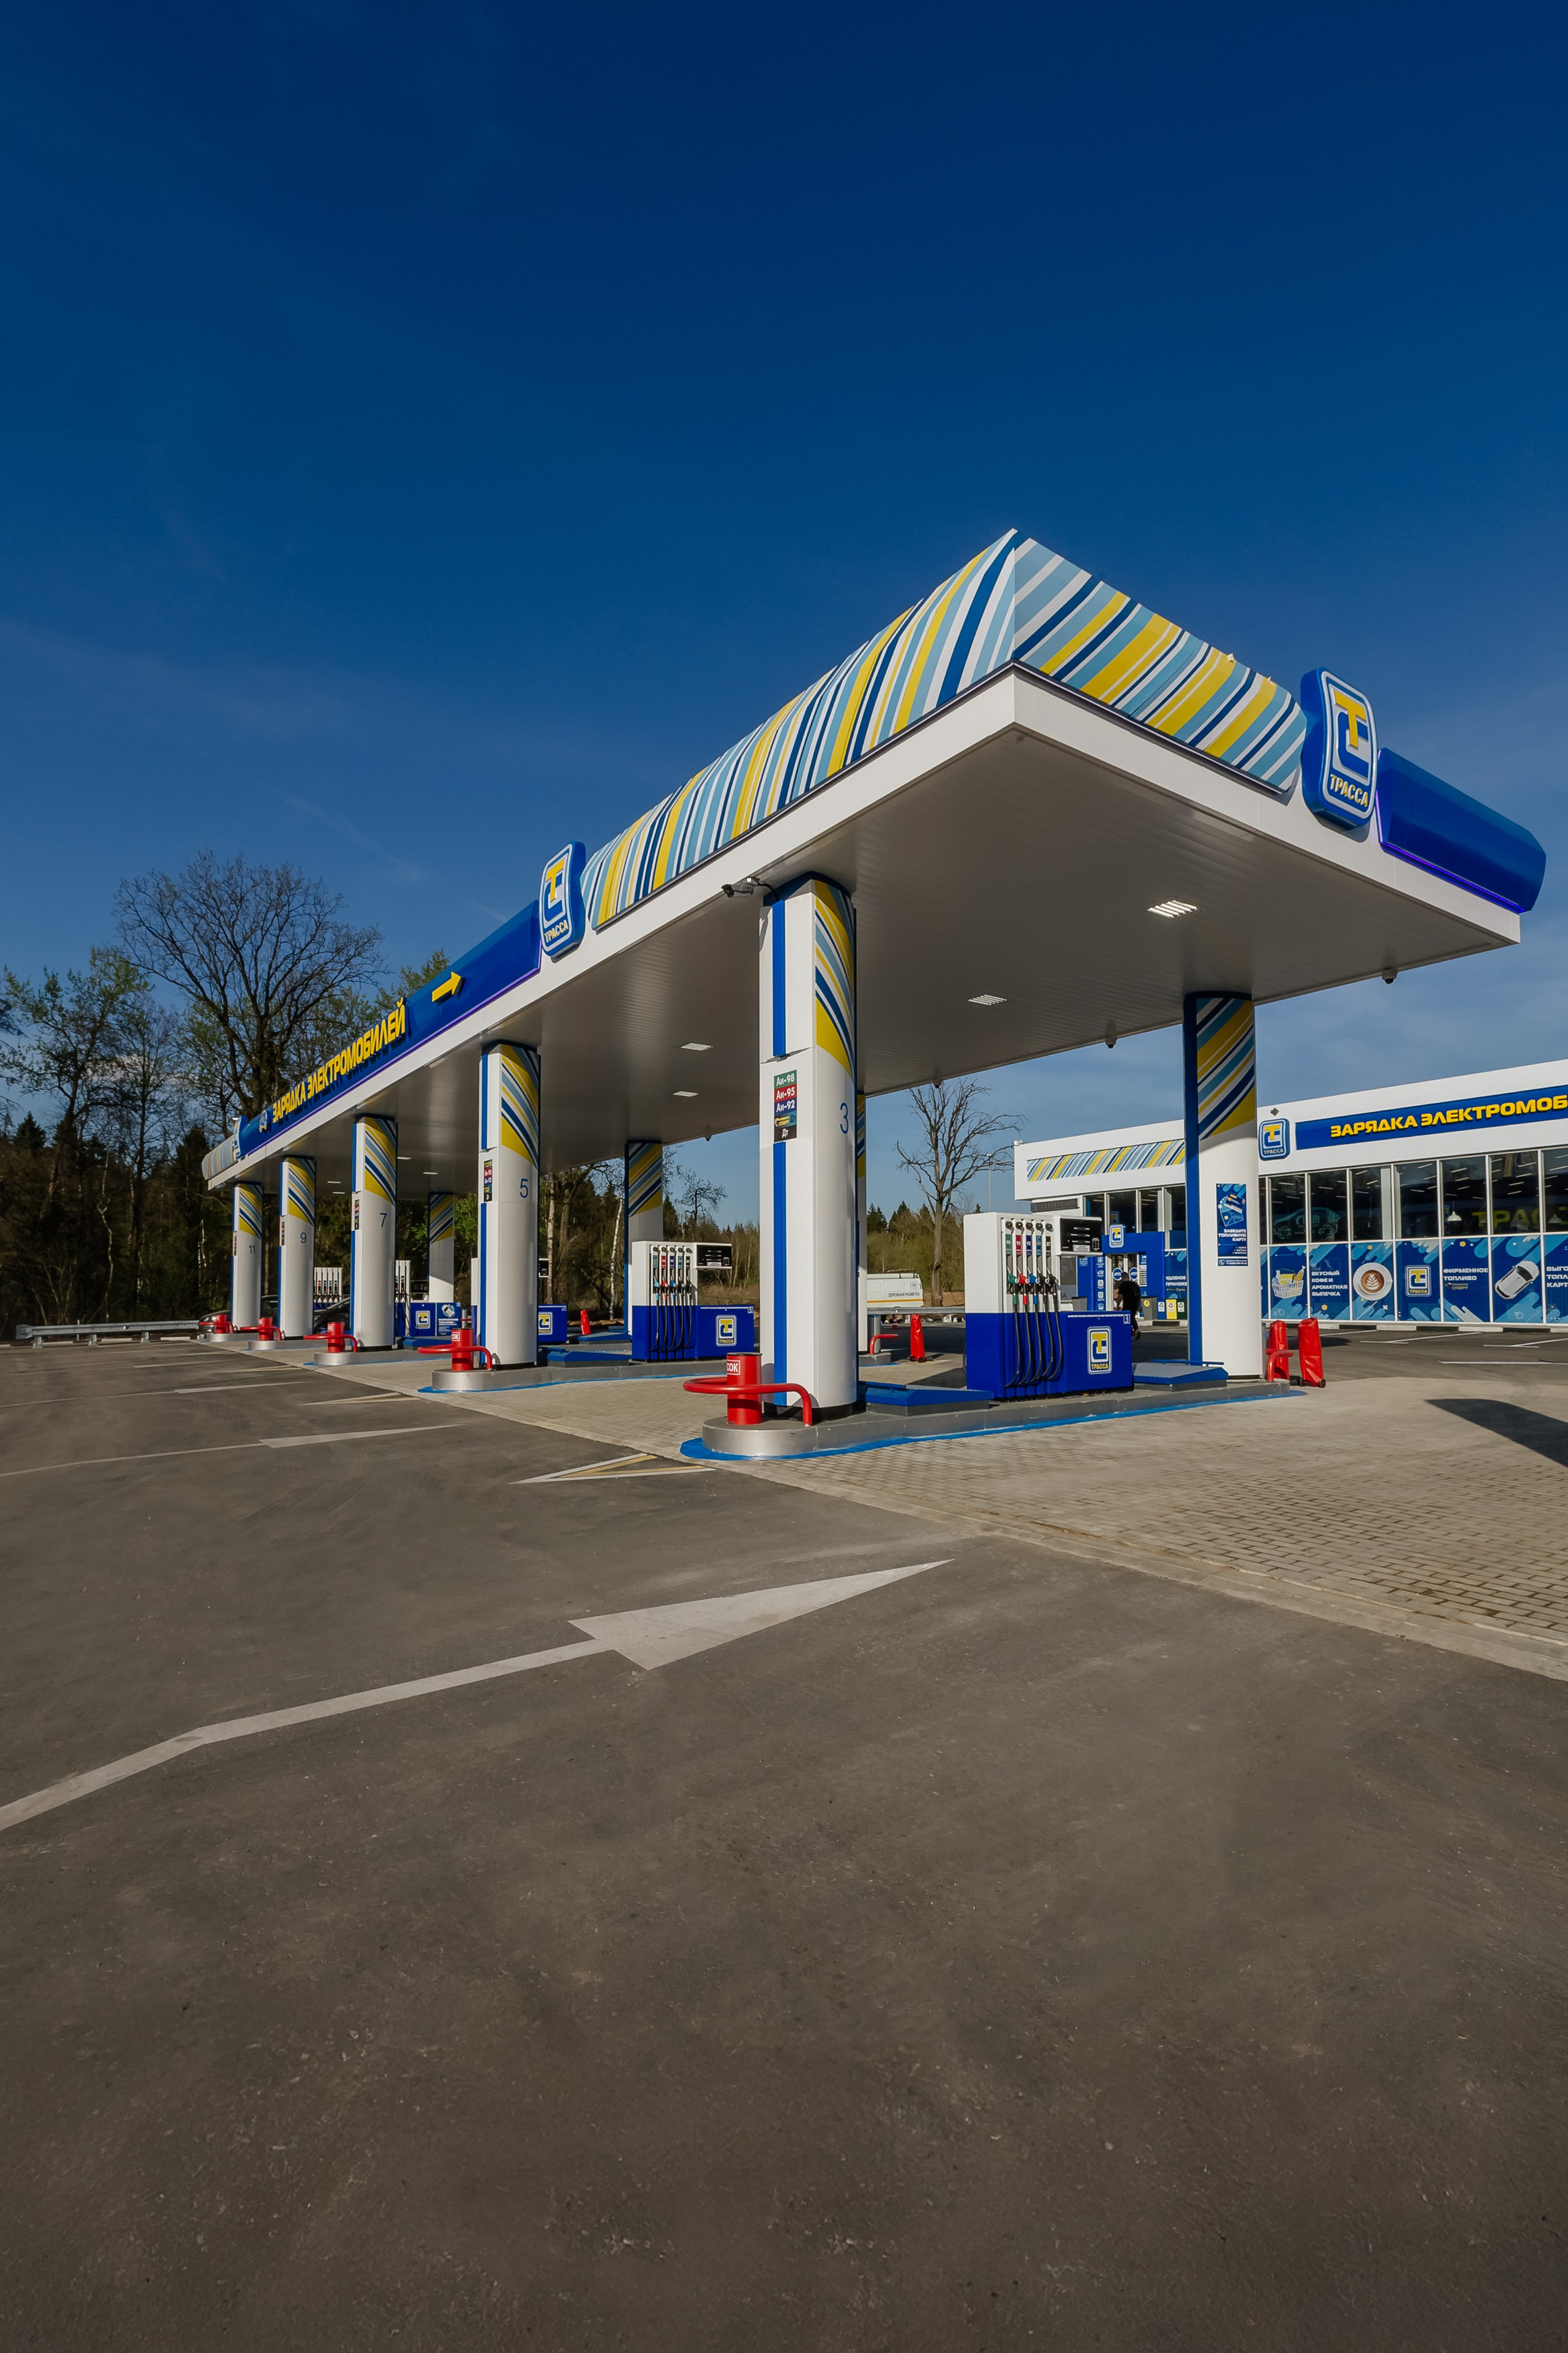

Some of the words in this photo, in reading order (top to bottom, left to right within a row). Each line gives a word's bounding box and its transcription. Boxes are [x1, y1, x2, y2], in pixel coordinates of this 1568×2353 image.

[1330, 774, 1368, 807] ТРАССА
[544, 920, 569, 943] ТРАССА
[273, 1081, 306, 1124] ЗАРЯДКА
[307, 997, 405, 1099] ЭЛЕКТРОМОБИЛЕЙ
[776, 1073, 795, 1086] Аи-98
[776, 1087, 795, 1100] Аи-95
[776, 1100, 795, 1112] Аи-92
[840, 1102, 849, 1135] 3
[1330, 1116, 1418, 1138] ЗАРЯДКА
[1420, 1095, 1568, 1126] ЭЛЕКТРОМОБ
[782, 1128, 789, 1138] Дт
[519, 1178, 529, 1198] 5
[380, 1212, 387, 1228] 7
[300, 1232, 307, 1244] 9
[249, 1244, 255, 1254] 11
